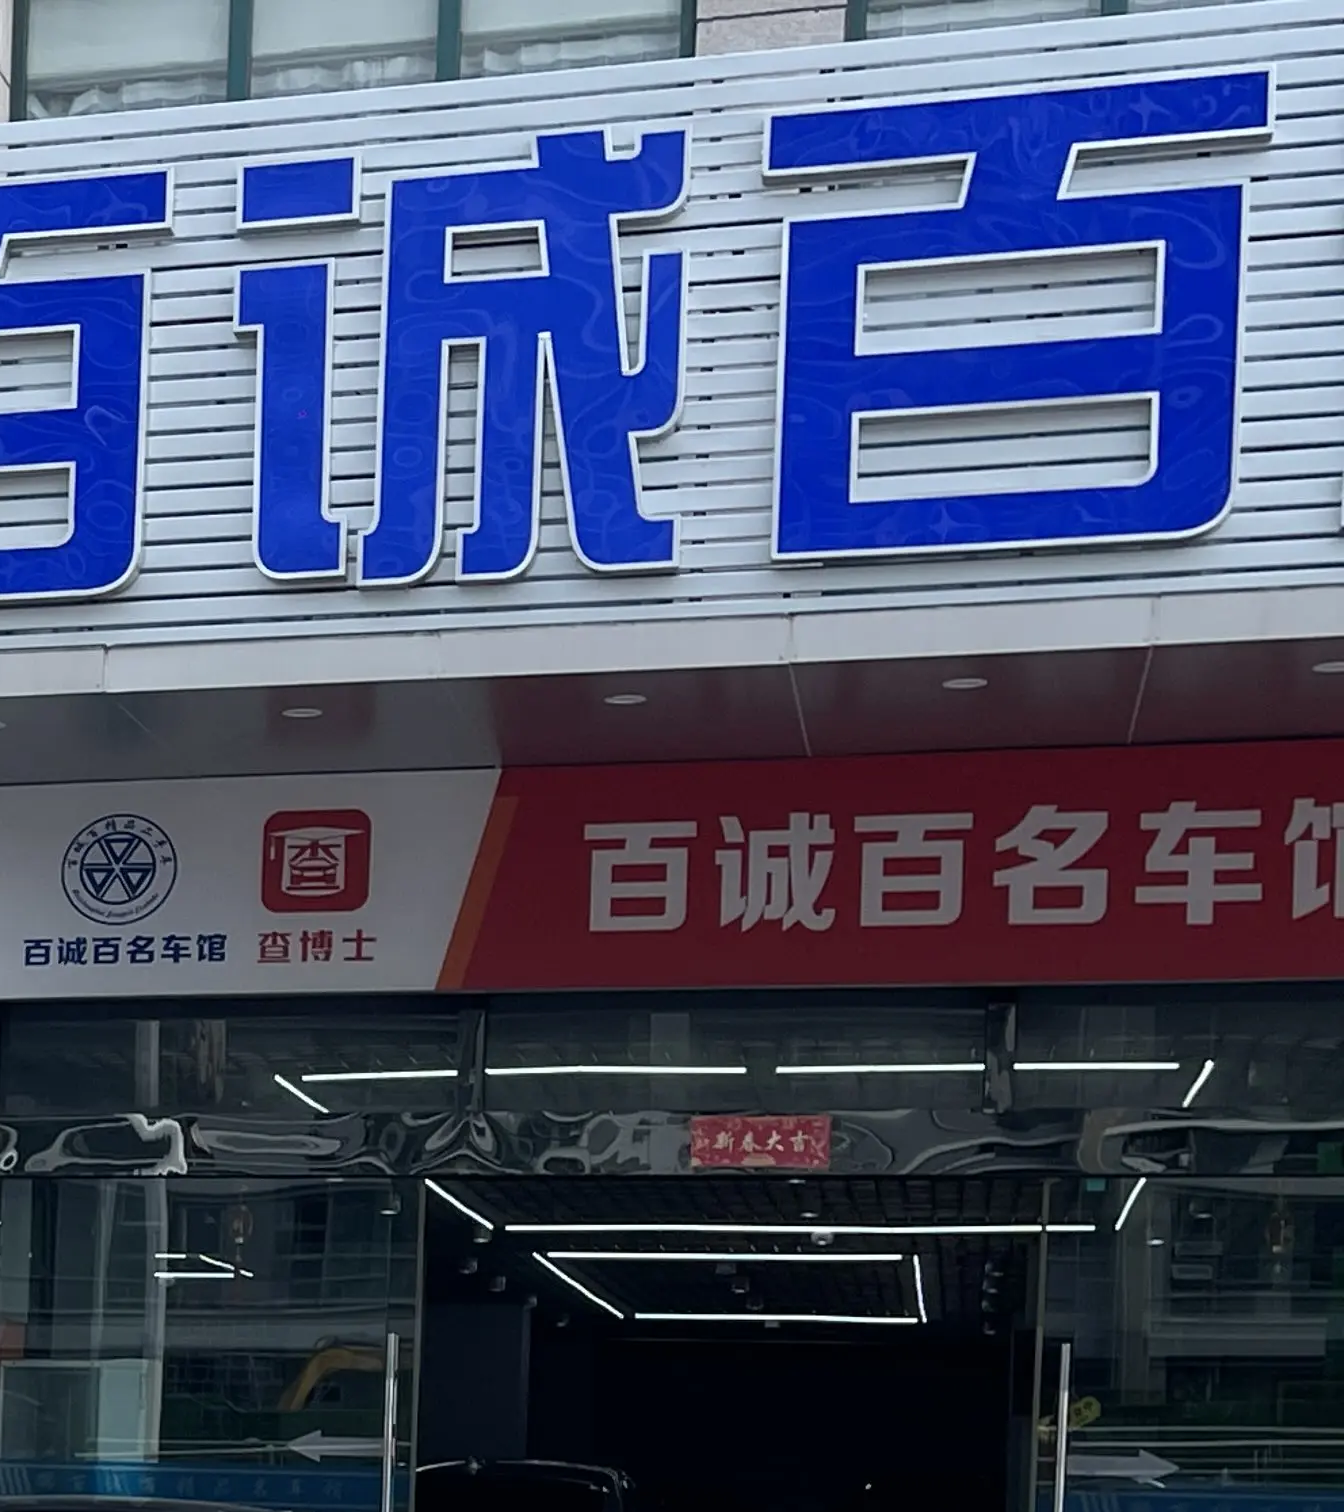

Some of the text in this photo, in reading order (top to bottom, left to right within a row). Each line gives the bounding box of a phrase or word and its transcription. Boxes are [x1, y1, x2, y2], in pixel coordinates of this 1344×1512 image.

[22, 932, 229, 967] 百诚百名车馆
[256, 929, 378, 964] 查博士
[712, 1130, 810, 1153] 新春大吉
